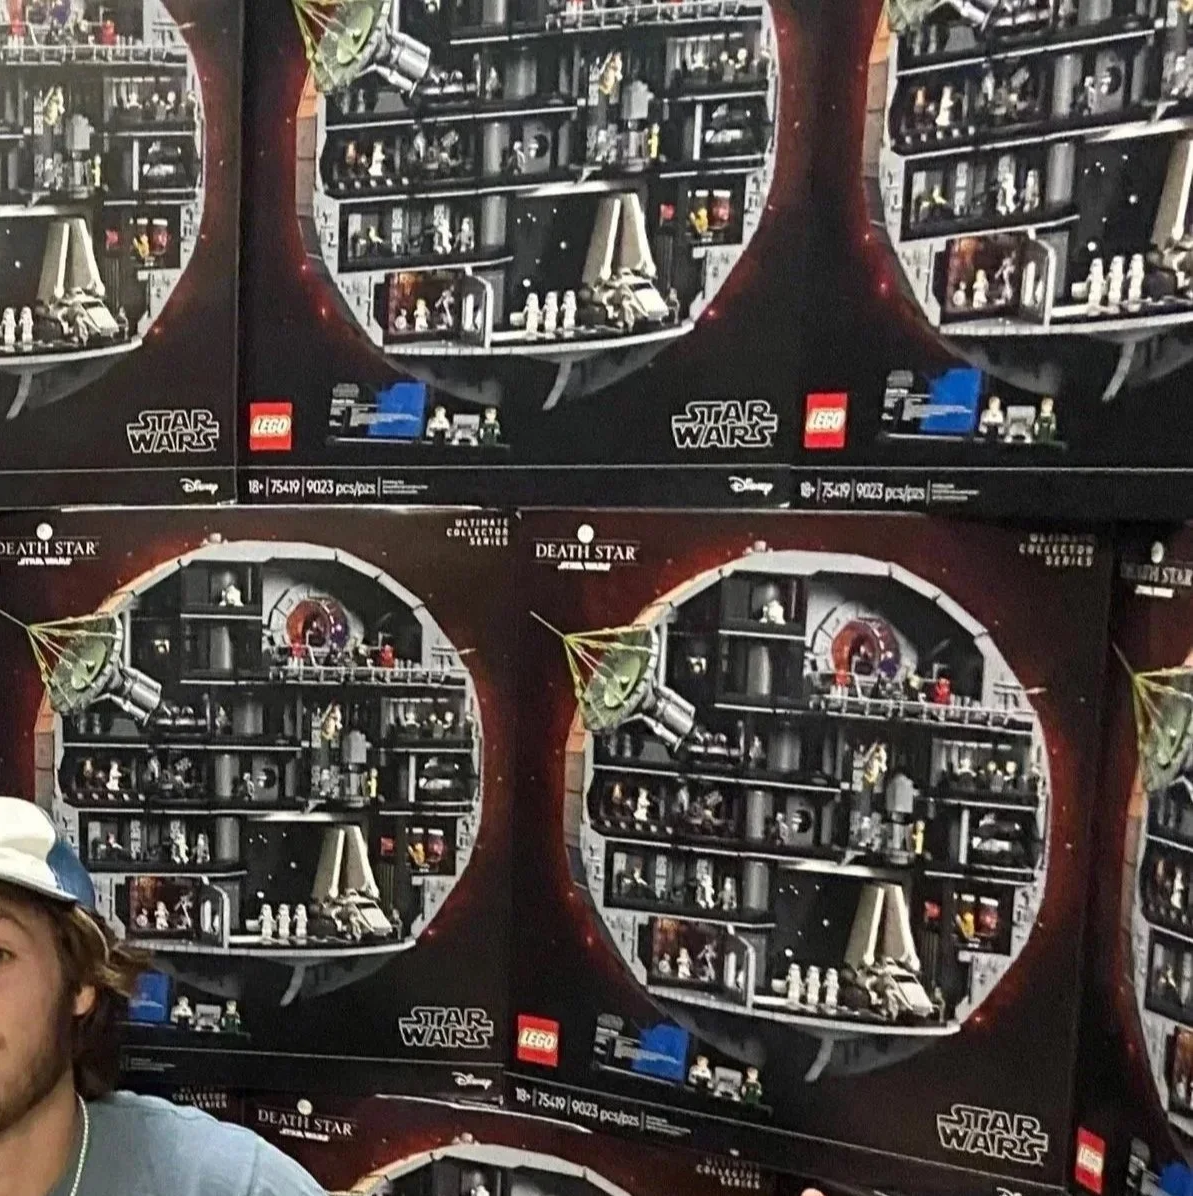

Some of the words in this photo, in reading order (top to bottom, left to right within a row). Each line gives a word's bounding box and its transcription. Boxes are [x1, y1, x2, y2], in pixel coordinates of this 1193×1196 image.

[127, 410, 219, 432] STAR
[672, 400, 777, 424] STAR
[805, 407, 846, 433] LEGO
[251, 416, 291, 436] LEGO
[673, 423, 777, 448] WARS
[128, 430, 219, 453] WARS
[248, 480, 264, 494] 18+
[271, 479, 300, 494] 75419
[306, 479, 334, 494] 9023
[335, 480, 376, 497] pcs/pzs
[856, 483, 883, 501] 9023
[446, 527, 509, 537] COLLECTOR
[469, 537, 509, 546] SERIES
[55, 541, 96, 556] STAR
[536, 544, 589, 560] DEATH
[595, 545, 636, 561] STAR
[399, 1006, 494, 1028] STAR
[401, 1024, 494, 1048] WARS
[518, 1028, 558, 1051] LEGO
[538, 1090, 566, 1110] 75419
[572, 1099, 598, 1118] 9023
[258, 1108, 309, 1129] DEATH
[314, 1118, 353, 1137] STAR
[936, 1104, 1048, 1143] STAR
[938, 1125, 1048, 1166] WARS
